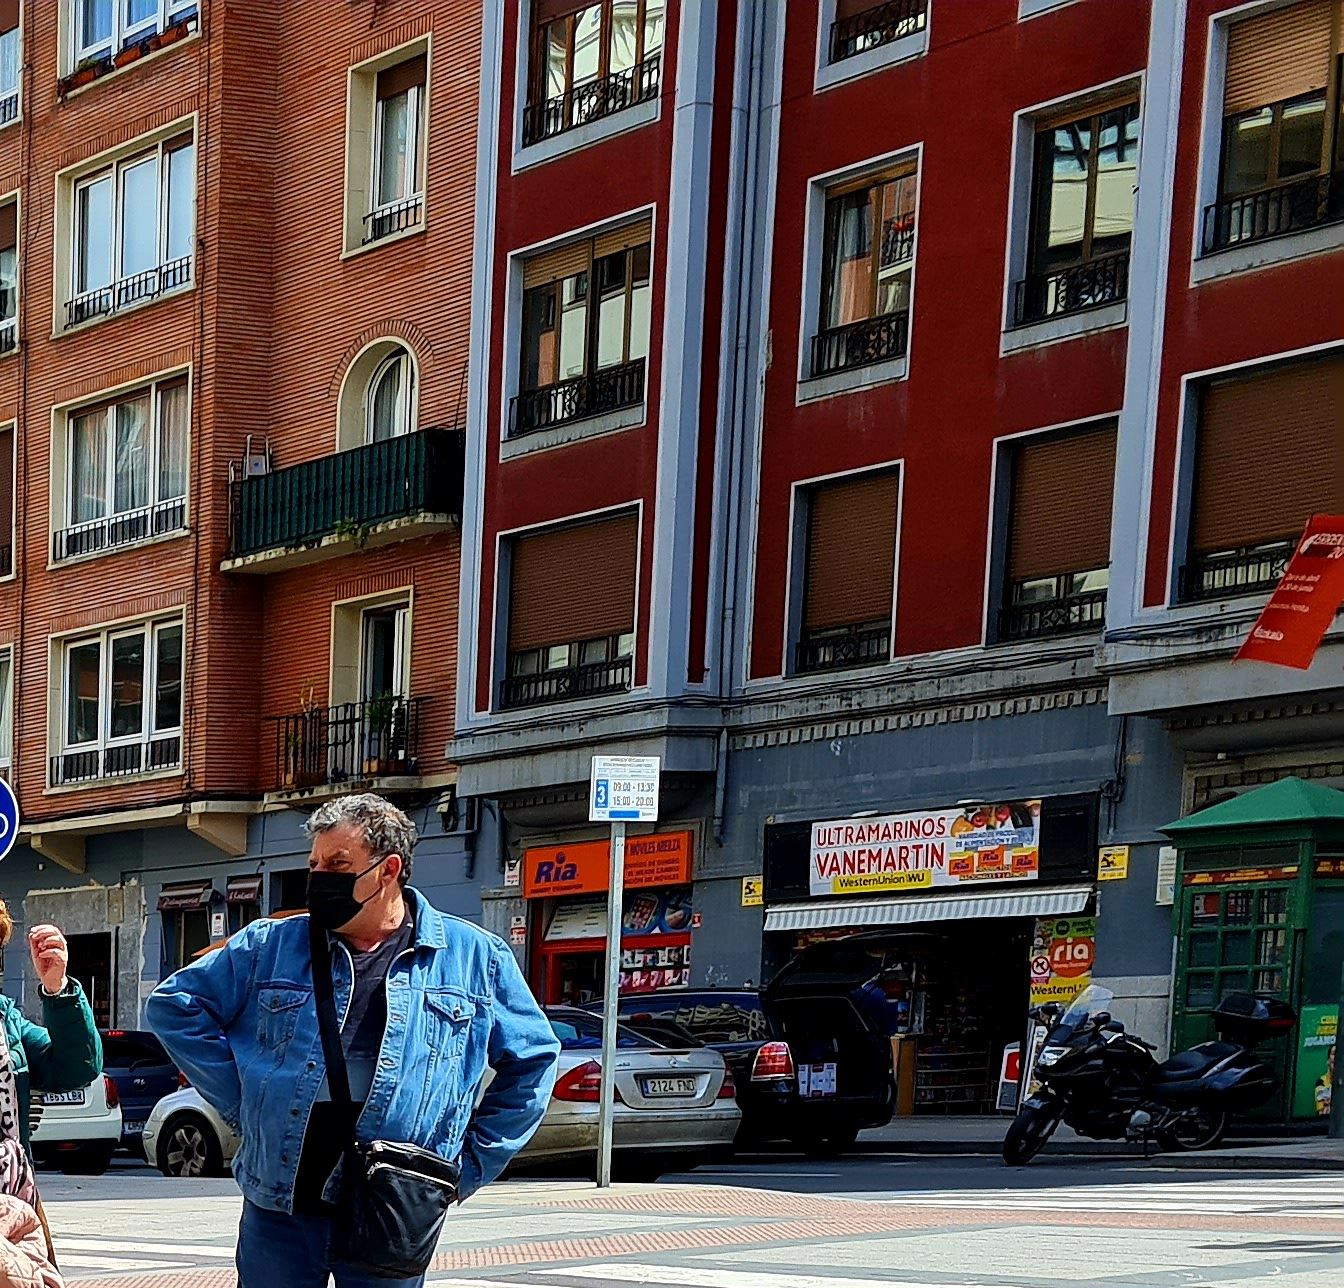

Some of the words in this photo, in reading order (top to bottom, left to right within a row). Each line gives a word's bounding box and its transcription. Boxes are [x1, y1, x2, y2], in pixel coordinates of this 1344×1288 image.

[597, 786, 606, 803] 3
[816, 816, 946, 847] ULTRAMARINOS
[534, 851, 577, 884] Ria
[815, 842, 945, 878] VANEMARTIN
[838, 876, 905, 888] WesternUnion
[1054, 938, 1089, 961] ria
[650, 1079, 674, 1092] 2124
